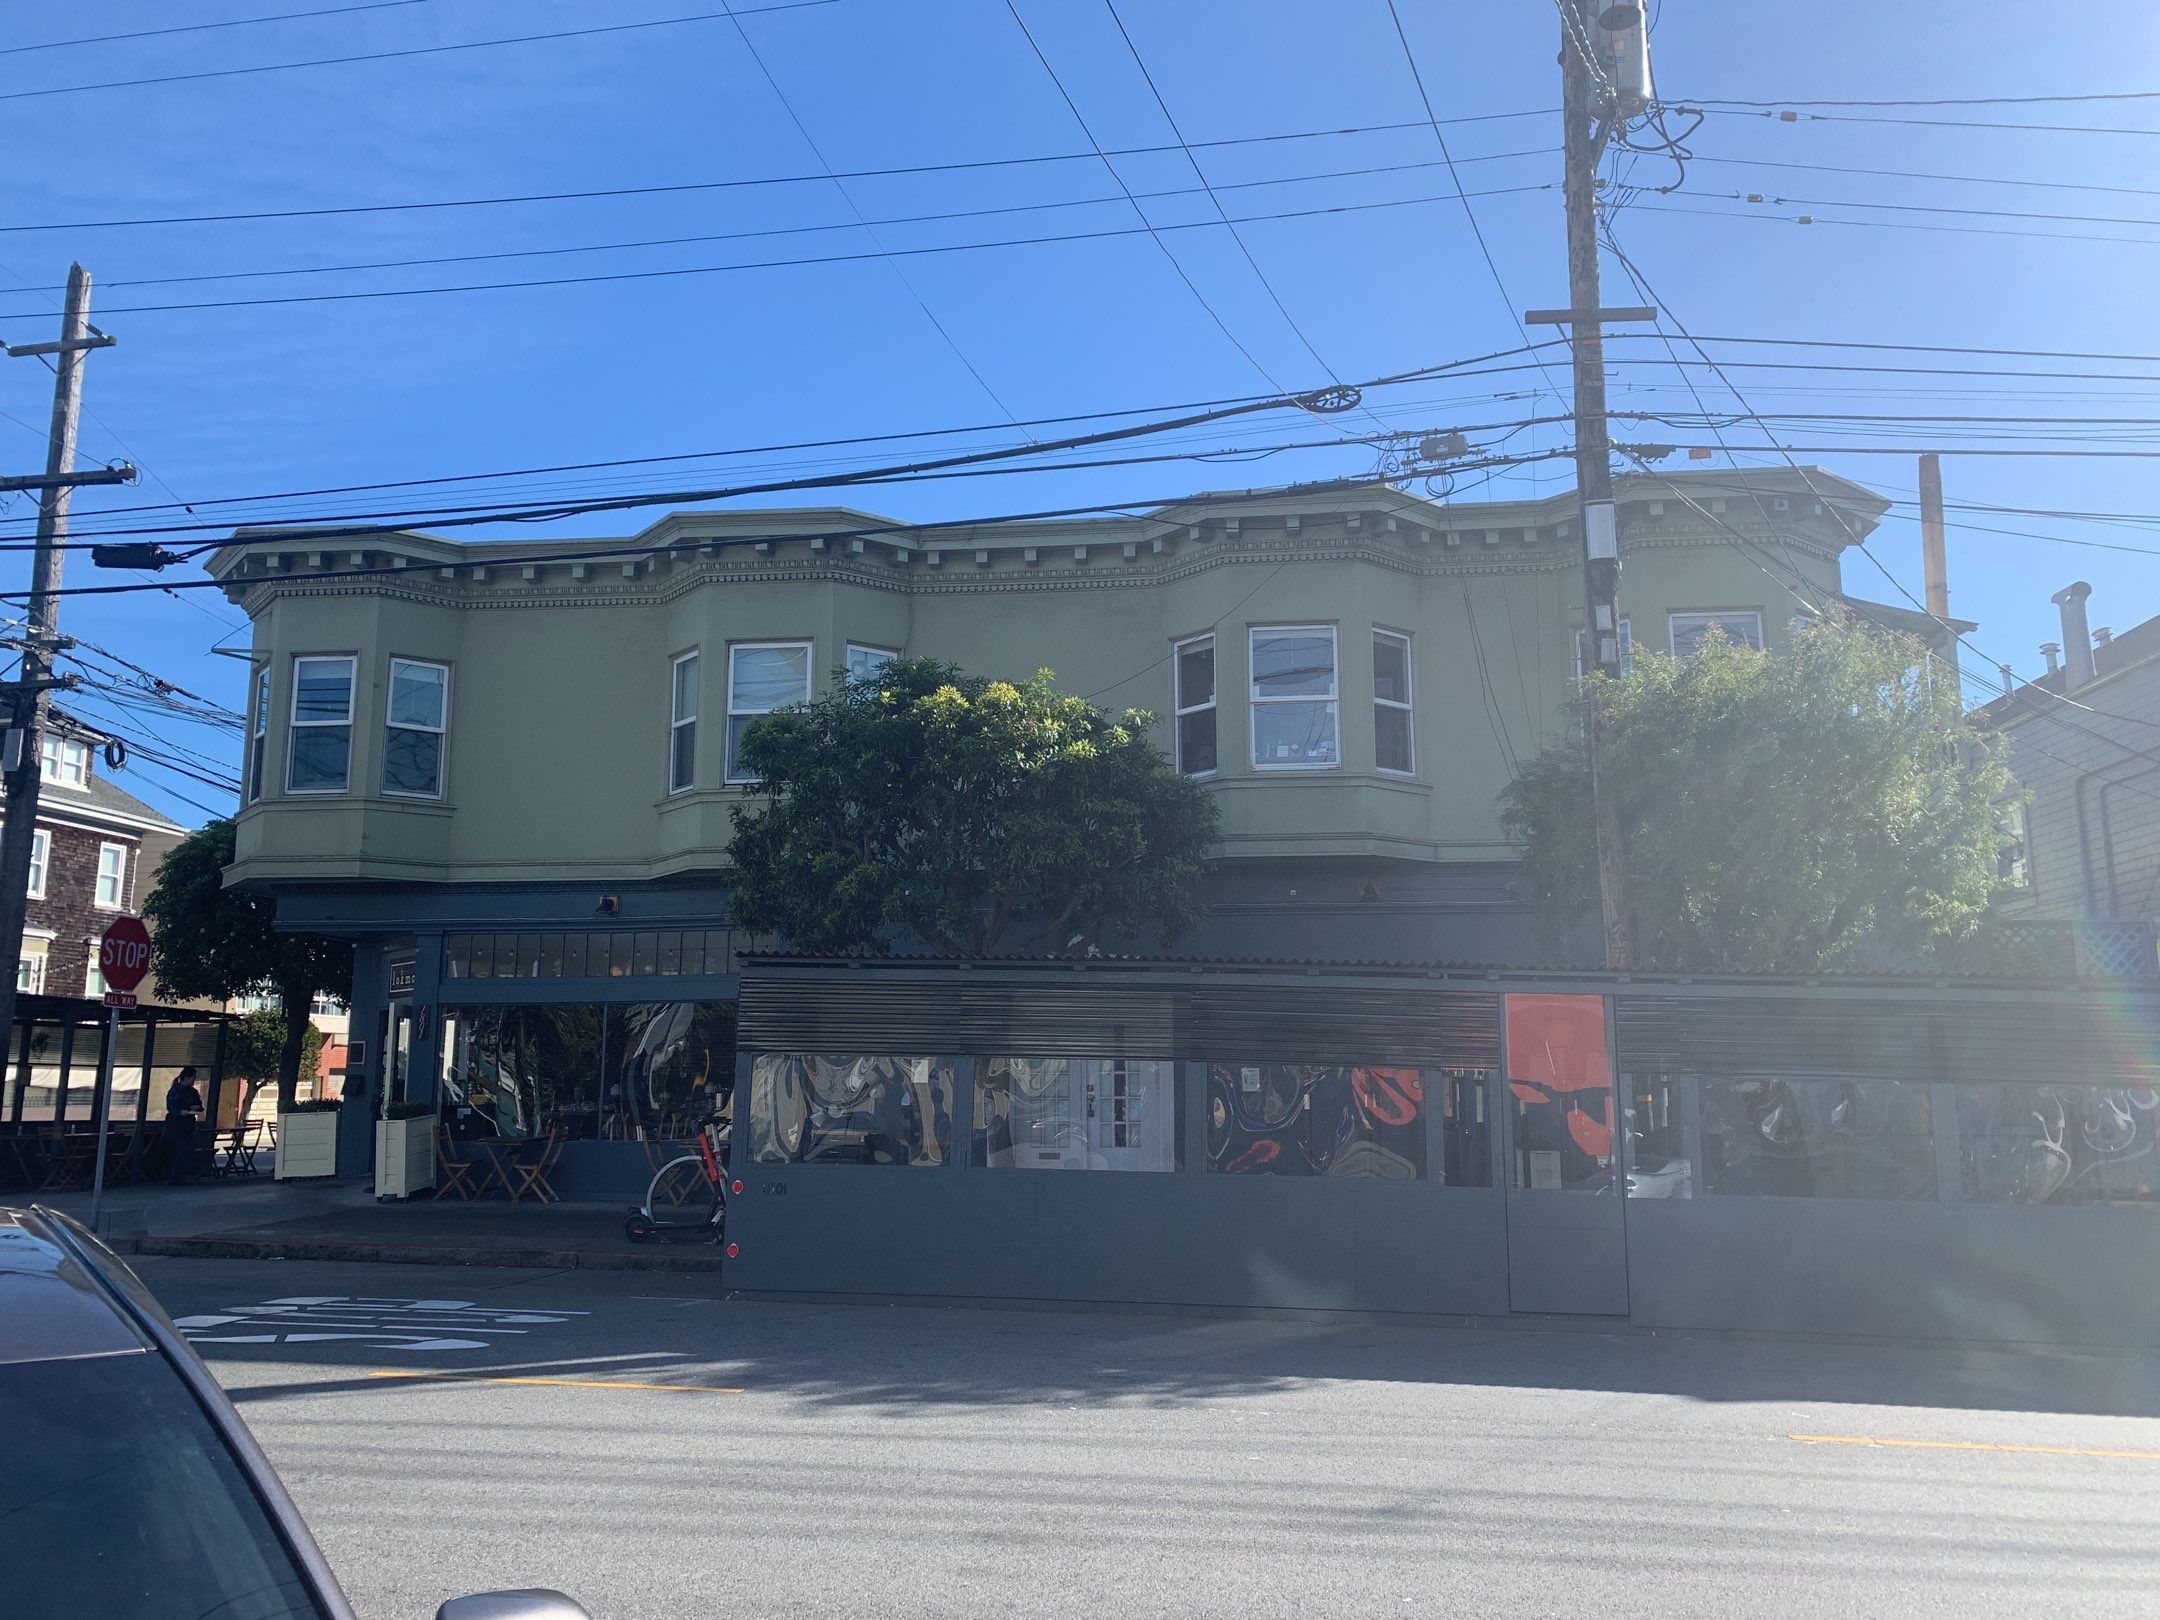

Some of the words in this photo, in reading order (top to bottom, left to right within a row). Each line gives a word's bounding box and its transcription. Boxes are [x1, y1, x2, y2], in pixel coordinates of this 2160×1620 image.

[103, 938, 147, 969] STOP
[106, 995, 118, 1005] ALL
[121, 996, 135, 1006] WAY
